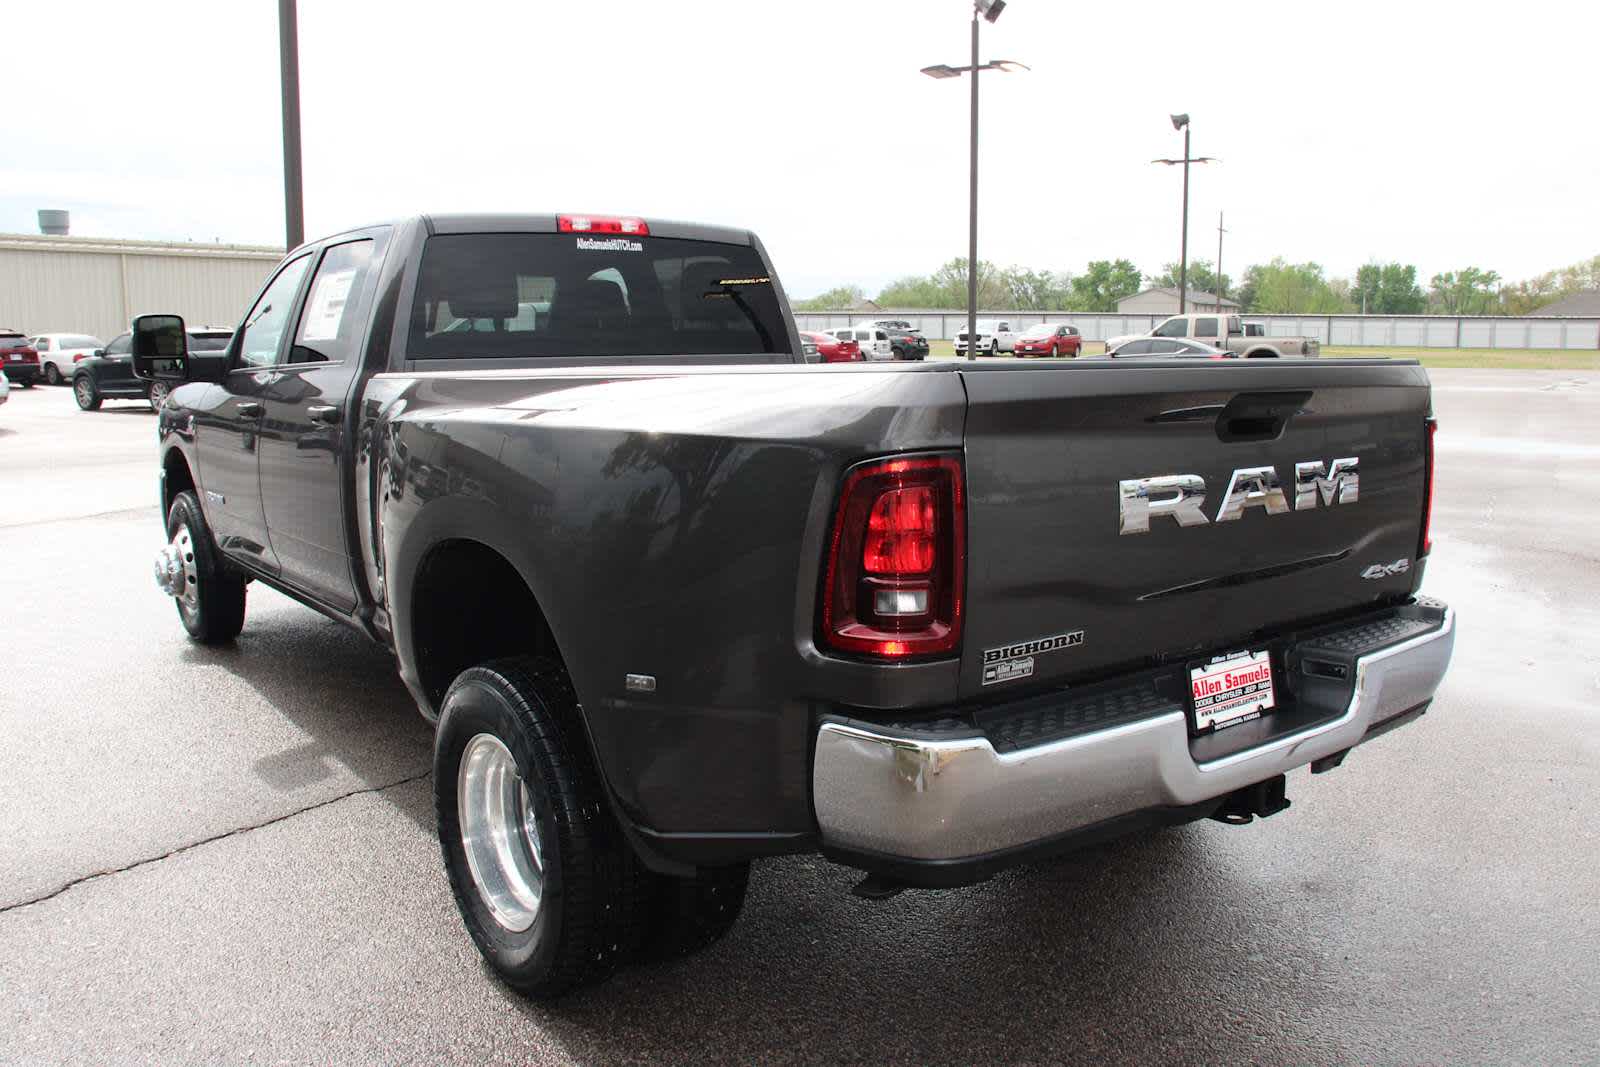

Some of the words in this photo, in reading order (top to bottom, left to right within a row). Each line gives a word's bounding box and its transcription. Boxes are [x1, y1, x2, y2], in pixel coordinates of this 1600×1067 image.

[1119, 457, 1359, 535] RAM
[984, 630, 1084, 664] BIGHORN
[1193, 679, 1222, 698] Allen
[1225, 665, 1270, 690] Samuels
[1195, 697, 1215, 708] DODGE
[1215, 688, 1243, 702] CHRYSLER
[1244, 684, 1257, 695] JEEP
[1257, 680, 1271, 691] RAM
